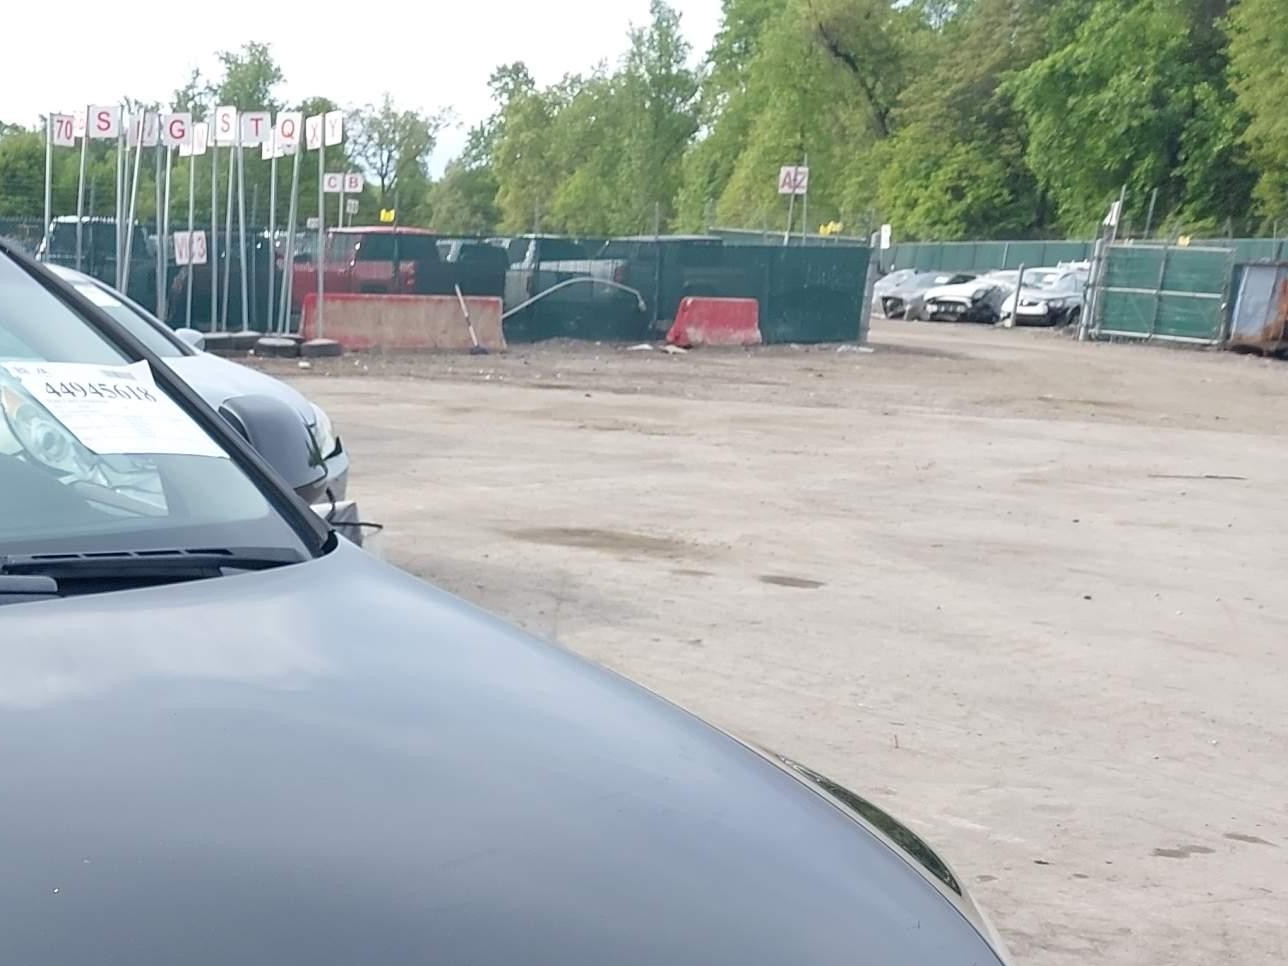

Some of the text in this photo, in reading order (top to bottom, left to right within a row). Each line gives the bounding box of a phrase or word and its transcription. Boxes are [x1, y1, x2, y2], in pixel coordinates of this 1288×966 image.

[56, 119, 73, 141] 70
[97, 111, 111, 131] S
[170, 119, 185, 139] G
[221, 113, 230, 133] S
[251, 117, 263, 137] T
[281, 119, 295, 139] Q
[328, 177, 337, 188] C
[349, 177, 359, 189] B
[45, 382, 157, 402] 44945618
